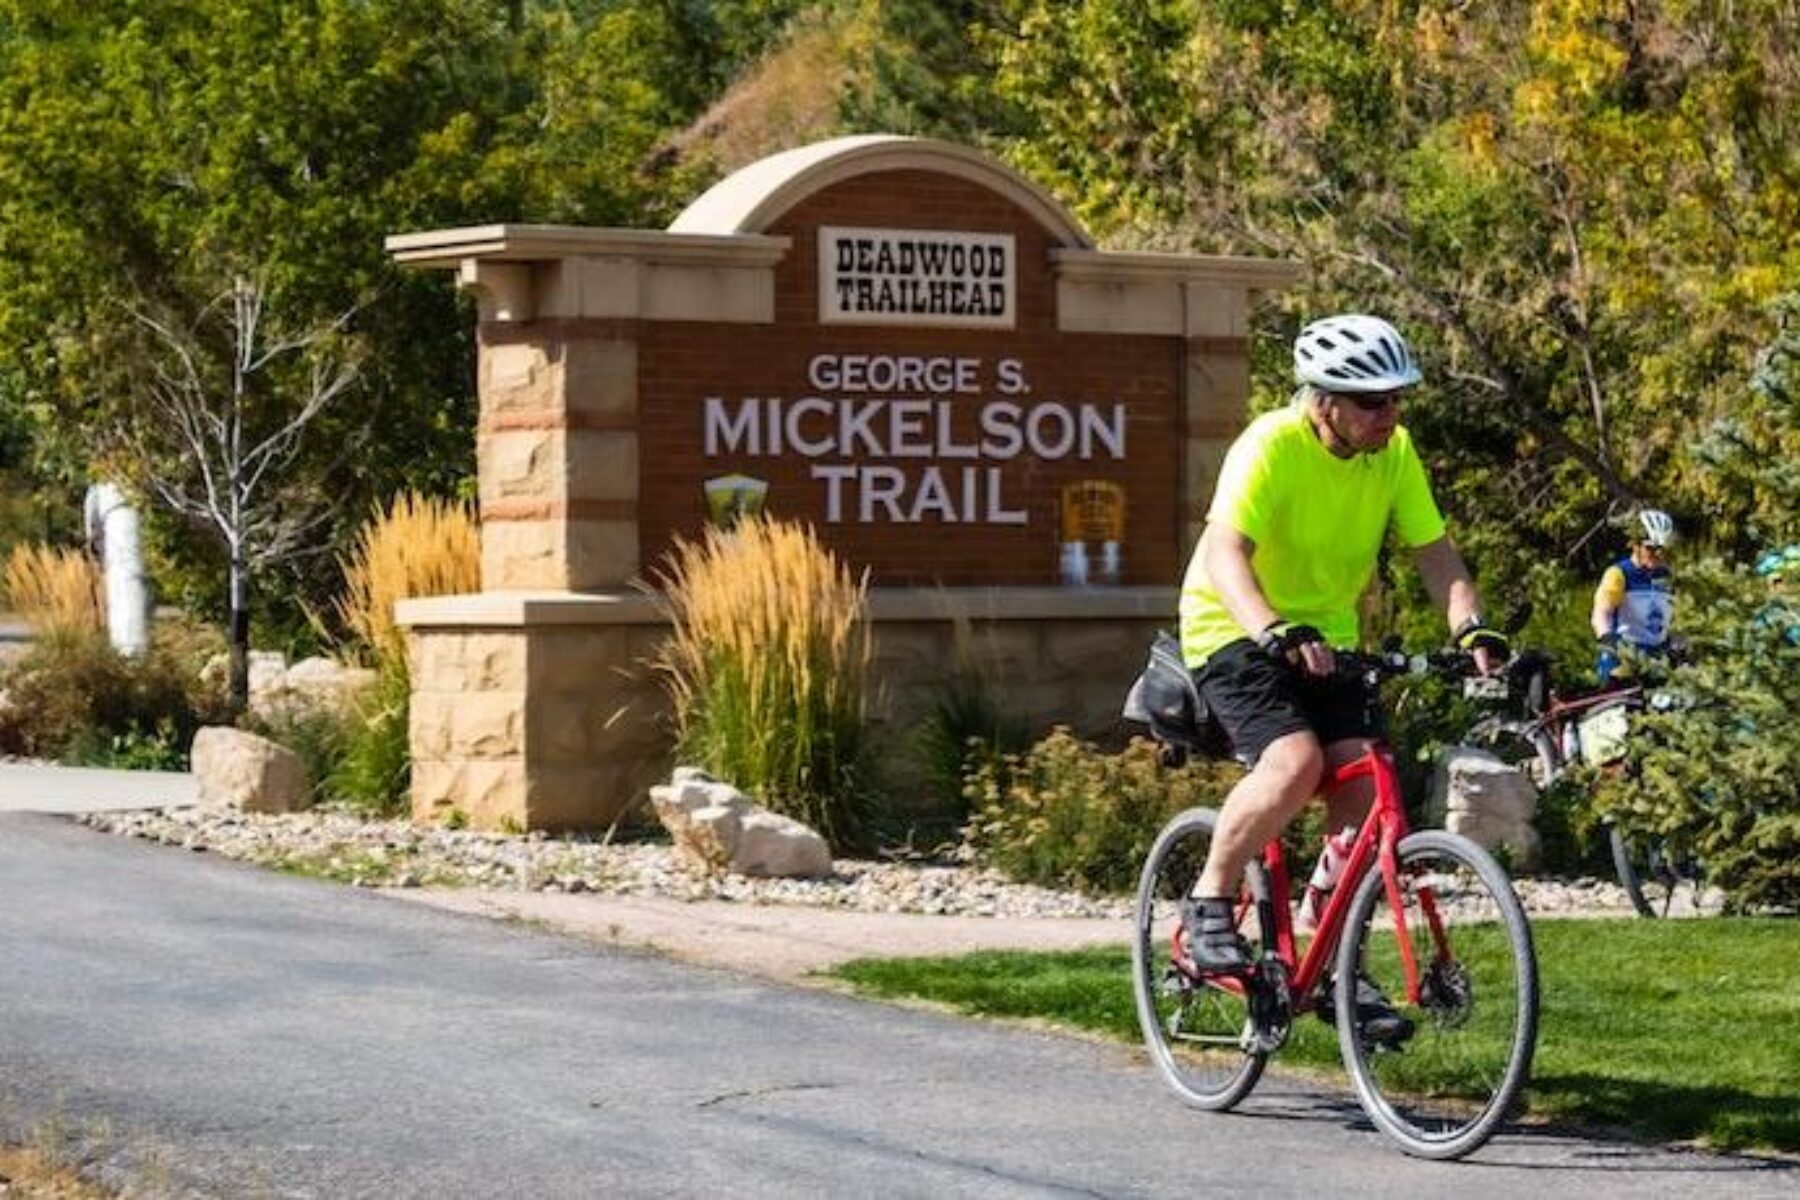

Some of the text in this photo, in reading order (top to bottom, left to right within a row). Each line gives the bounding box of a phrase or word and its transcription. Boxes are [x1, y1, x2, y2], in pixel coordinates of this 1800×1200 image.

[836, 239, 1006, 277] DEADWOOD
[836, 278, 1006, 316] TRAILHEAD
[808, 354, 1031, 394] GEORGE S.
[704, 397, 1126, 460] MICKELSON
[811, 464, 1028, 524] TRAIL
